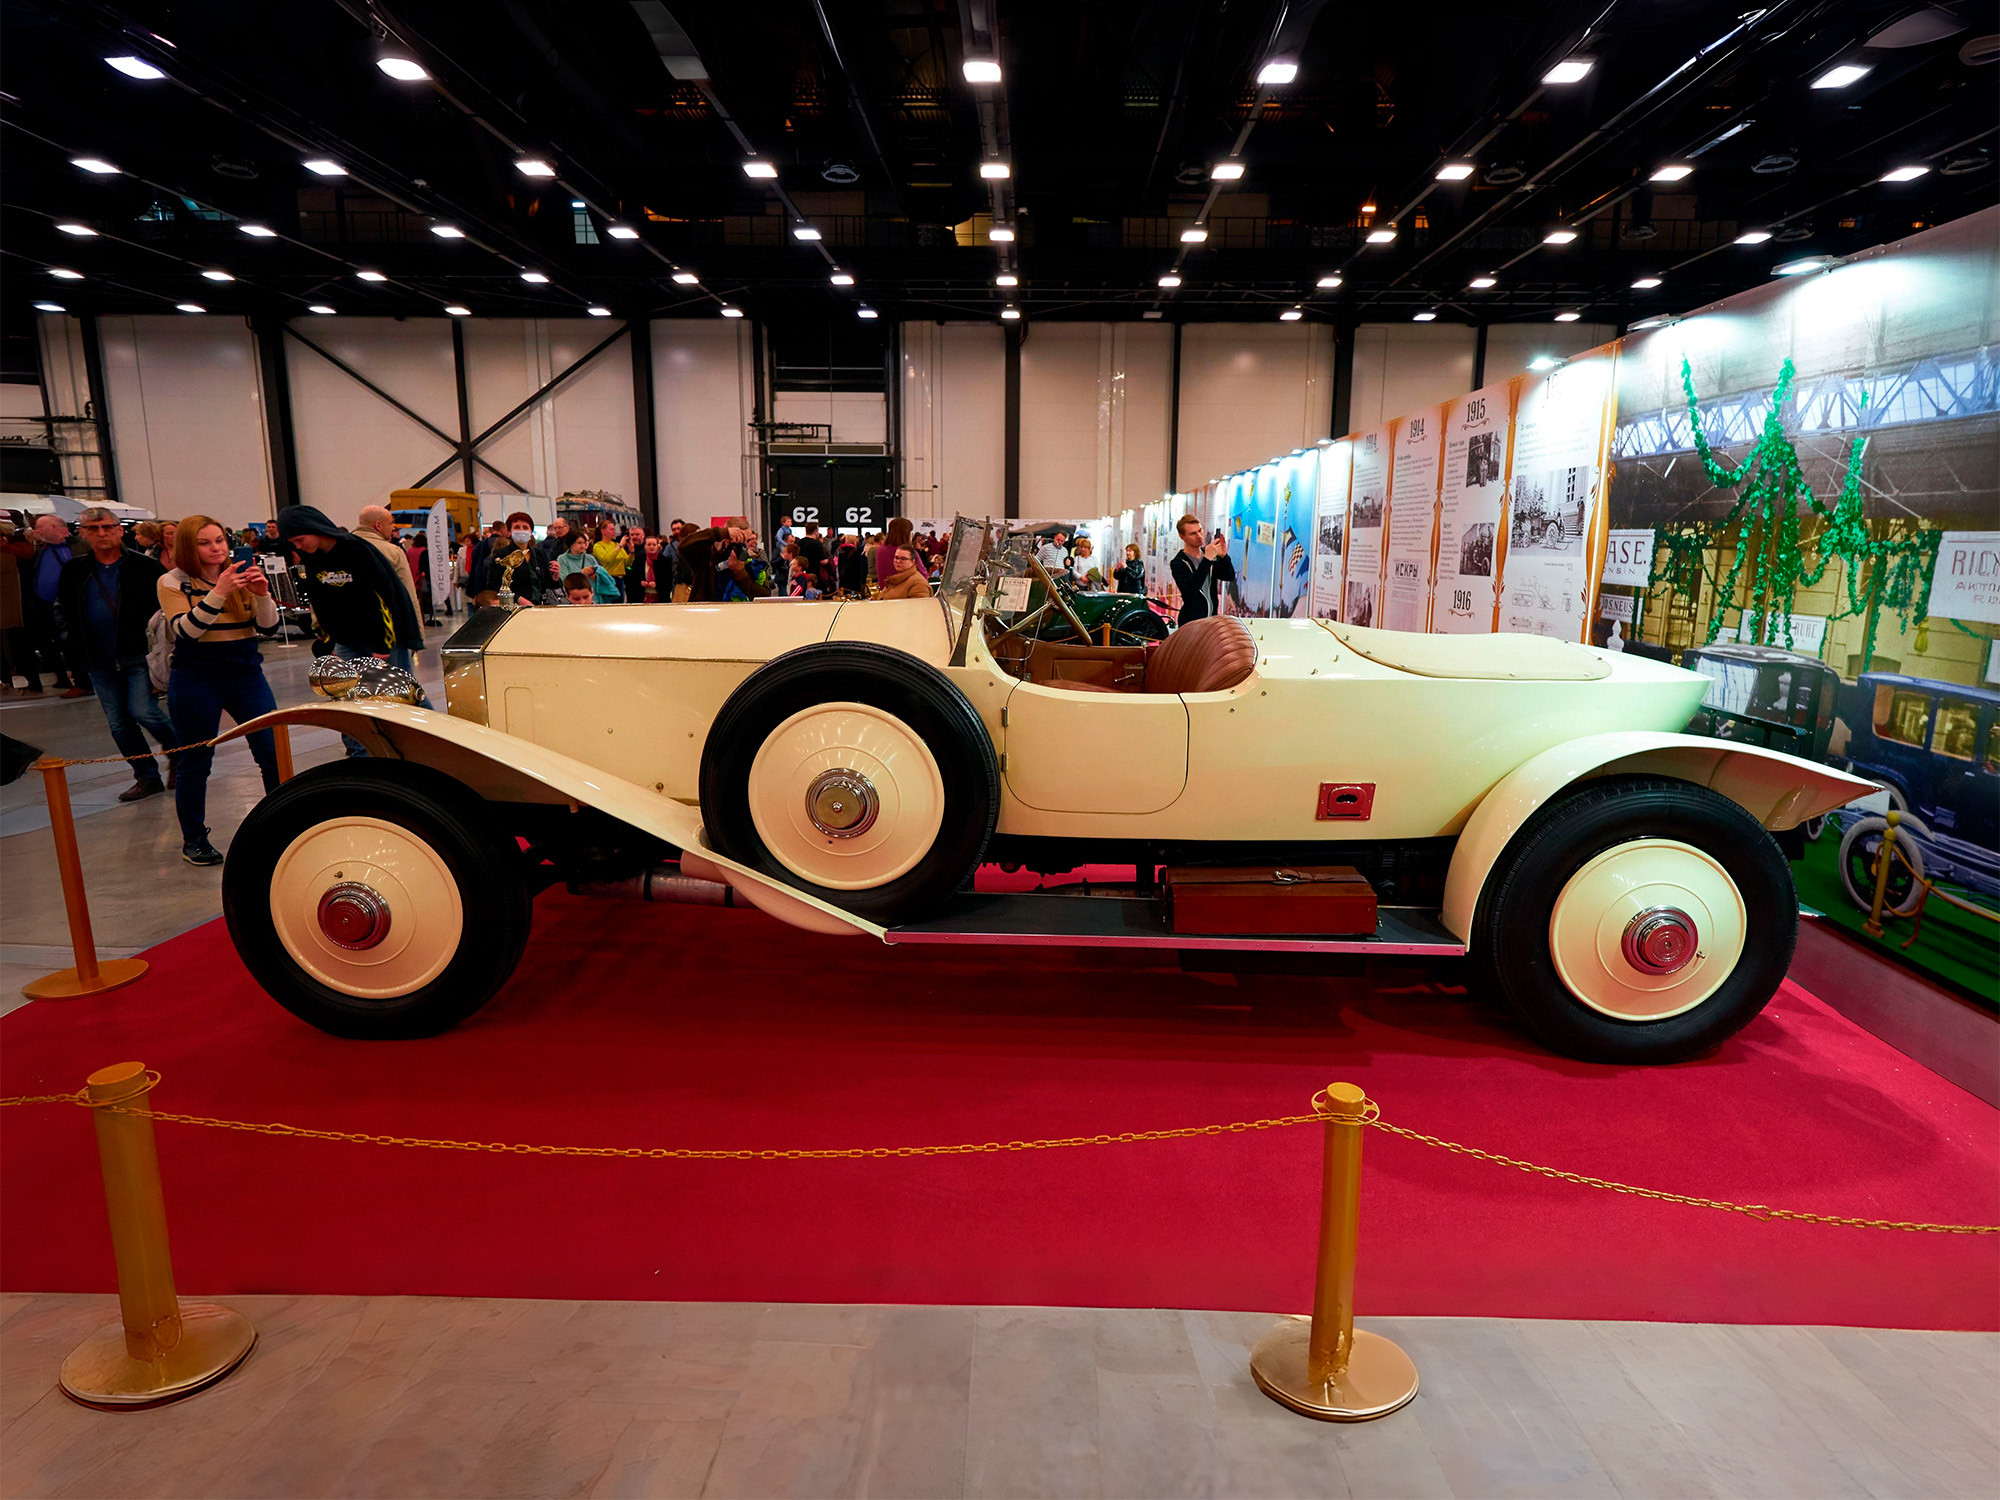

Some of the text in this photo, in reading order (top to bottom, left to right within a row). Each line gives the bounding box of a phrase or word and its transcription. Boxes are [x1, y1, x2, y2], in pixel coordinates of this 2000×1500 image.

[1466, 398, 1486, 423] 1915
[1410, 417, 1425, 438] 1914
[1365, 432, 1377, 450] 1914
[792, 506, 819, 523] 62
[845, 507, 872, 523] 62
[1394, 563, 1419, 578] ИСКРЫ
[1453, 589, 1472, 611] 1916
